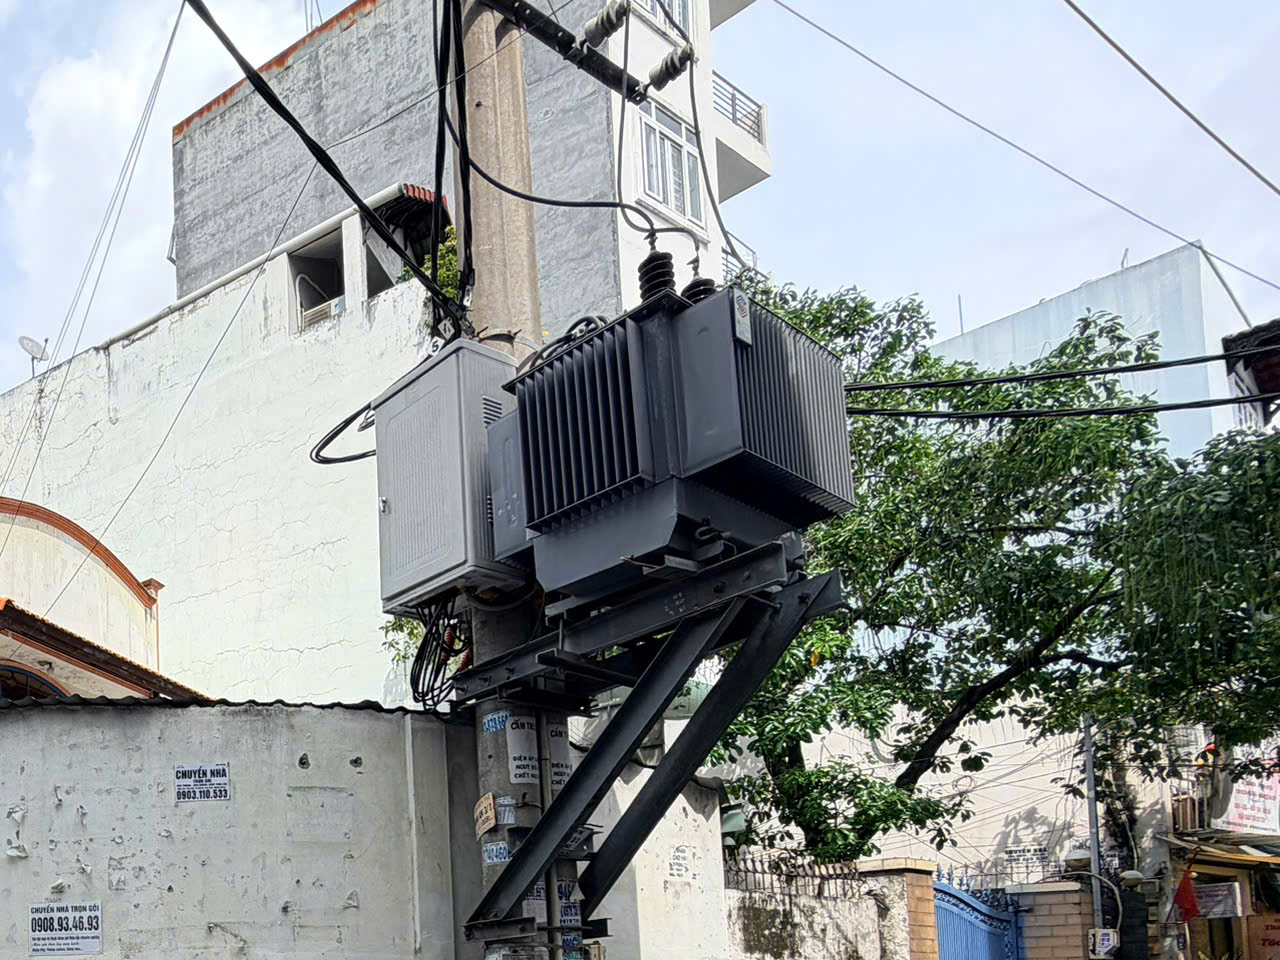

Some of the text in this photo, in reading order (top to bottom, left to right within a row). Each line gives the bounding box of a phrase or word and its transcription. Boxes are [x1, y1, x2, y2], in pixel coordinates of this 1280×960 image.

[210, 767, 227, 778] NHÀ
[176, 789, 228, 800] 0903.110.533
[56, 904, 69, 913] NHÀ
[31, 915, 100, 933] 0908.93.46.93
